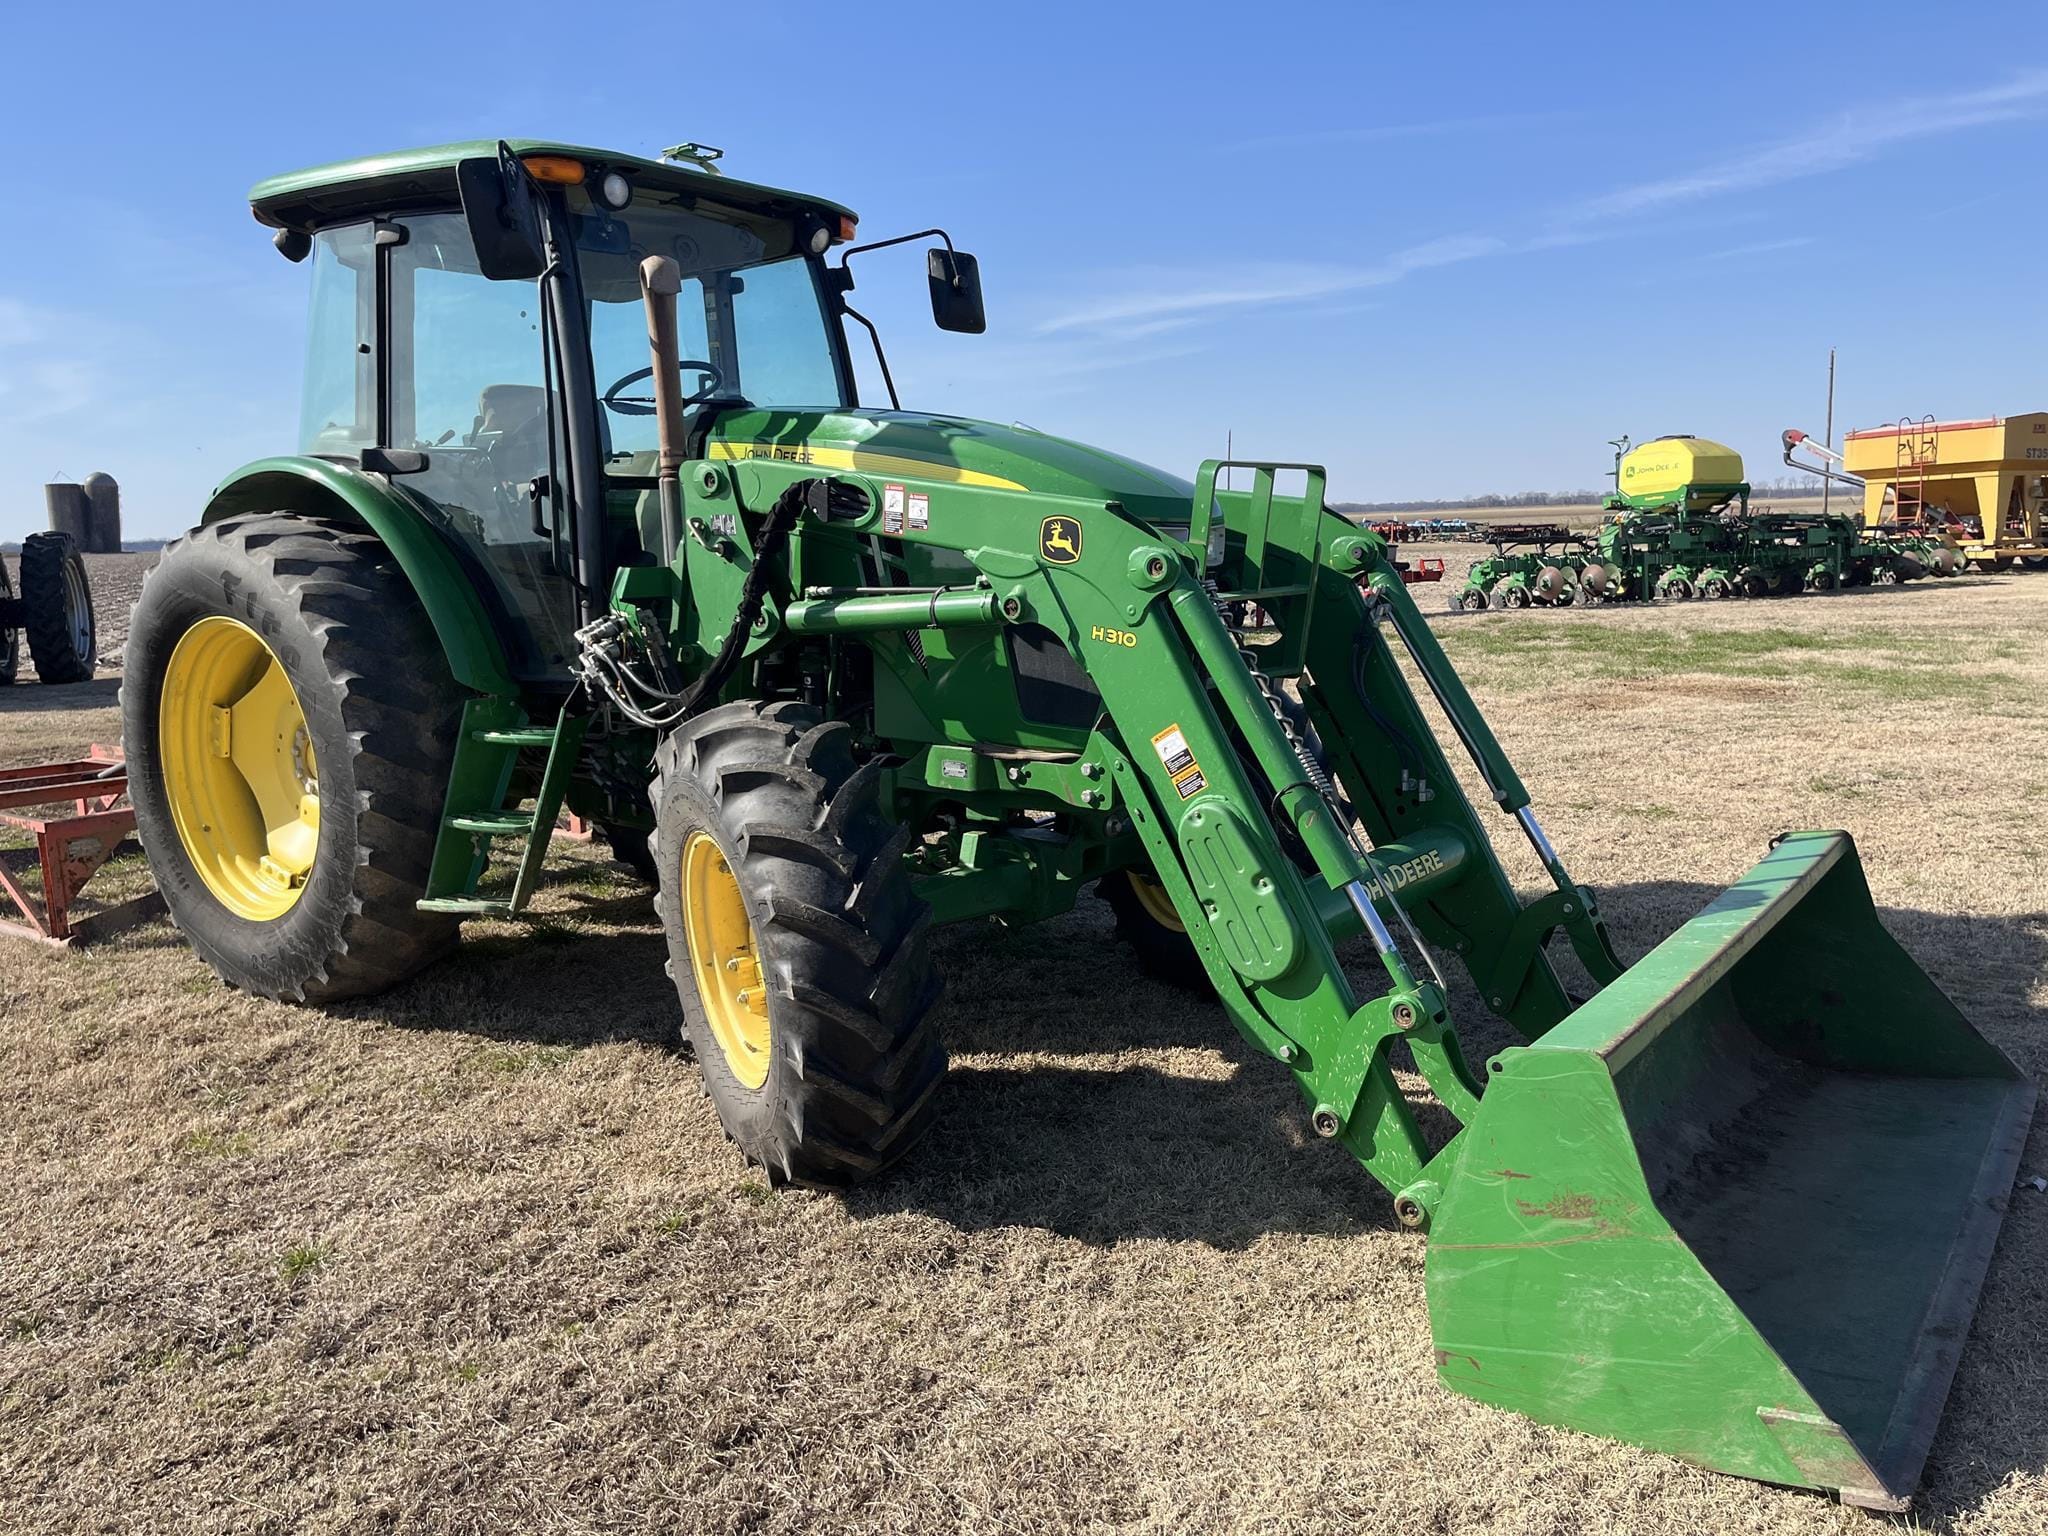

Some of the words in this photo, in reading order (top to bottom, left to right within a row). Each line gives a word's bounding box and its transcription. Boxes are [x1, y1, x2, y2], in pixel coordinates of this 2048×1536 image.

[741, 446, 772, 460] JOHN
[774, 448, 815, 464] DEERE
[1091, 625, 1137, 648] H310
[1360, 873, 1395, 901] OHN
[1388, 850, 1444, 889] DEERE
